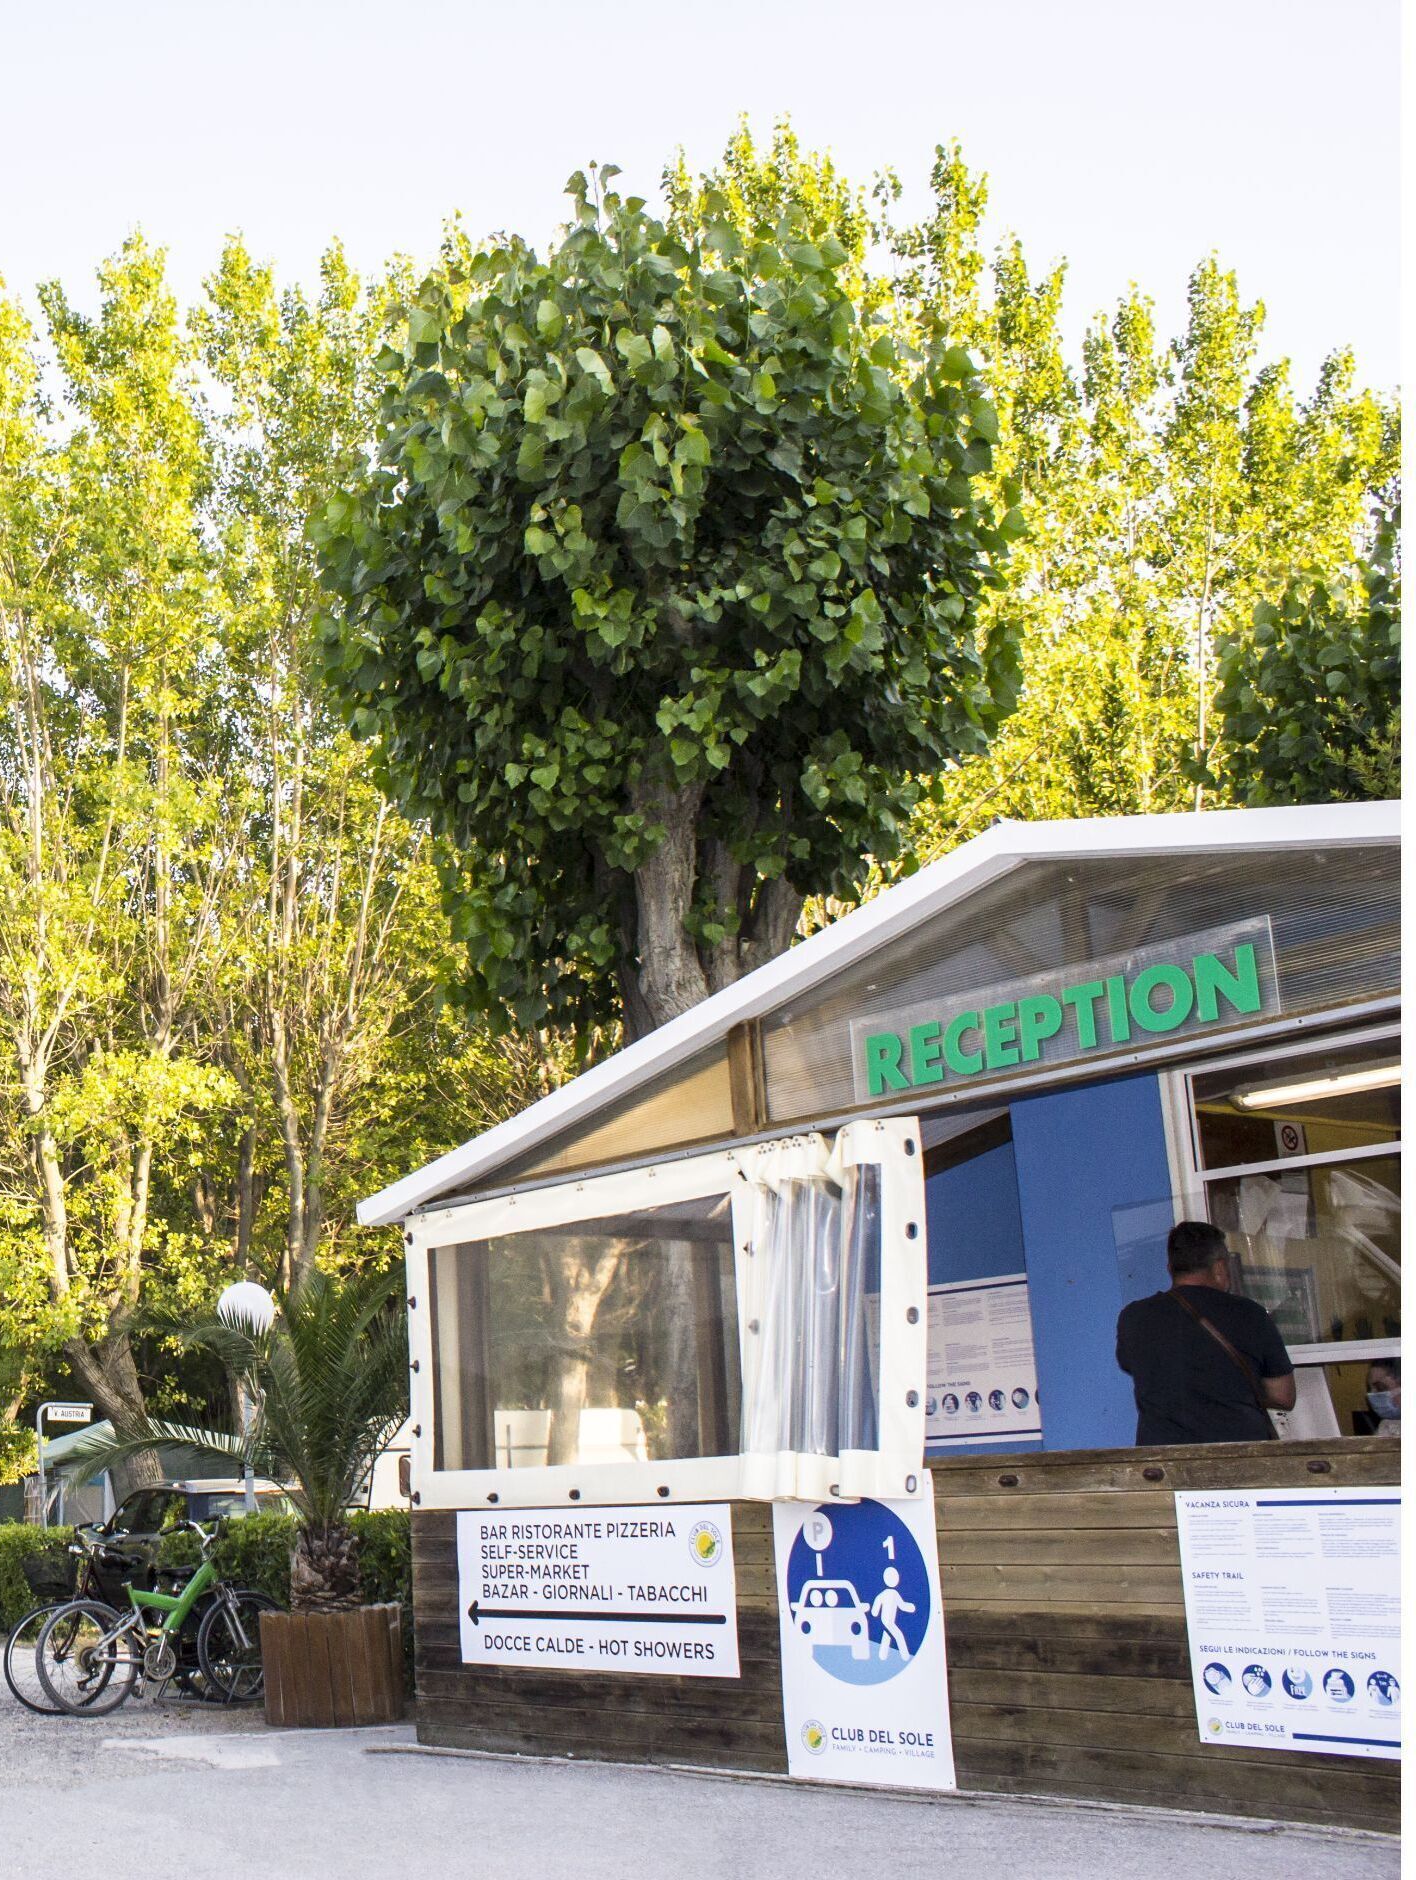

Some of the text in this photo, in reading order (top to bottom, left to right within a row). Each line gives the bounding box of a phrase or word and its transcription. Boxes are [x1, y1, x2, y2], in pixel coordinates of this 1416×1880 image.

[865, 943, 1261, 1096] RECEPTION
[61, 1410, 85, 1418] AUSTRIA
[480, 1521, 676, 1540] BAR RISTORANTE PIZZERIA
[812, 1521, 824, 1542] P
[481, 1544, 578, 1560] SELF-SERVICE
[882, 1535, 895, 1560] 1
[482, 1564, 590, 1580] SUPER-MARKET
[1192, 1571, 1245, 1580] SAFETY TRAIL
[483, 1583, 529, 1600] BAZAR
[543, 1584, 613, 1602] GIORNALI
[627, 1585, 708, 1603] TABACCHI
[484, 1634, 532, 1652] DOCCE
[535, 1636, 585, 1654] CALDE
[598, 1639, 629, 1656] HOT
[633, 1640, 715, 1660] SHOWERS
[1199, 1645, 1222, 1653] SEGUI
[1223, 1646, 1234, 1654] LE
[1235, 1646, 1286, 1656] INDICAZIONI
[1293, 1649, 1329, 1658] FOLLOW
[1332, 1650, 1349, 1659] THE
[1350, 1651, 1377, 1660] SIGNS
[1225, 1721, 1286, 1732] CLUB DEL SOLE
[831, 1727, 865, 1742] CLUB
[868, 1729, 894, 1744] DEL
[898, 1731, 934, 1747] SOLE
[832, 1743, 935, 1759] FAMILY CAMPING VILLAGE
